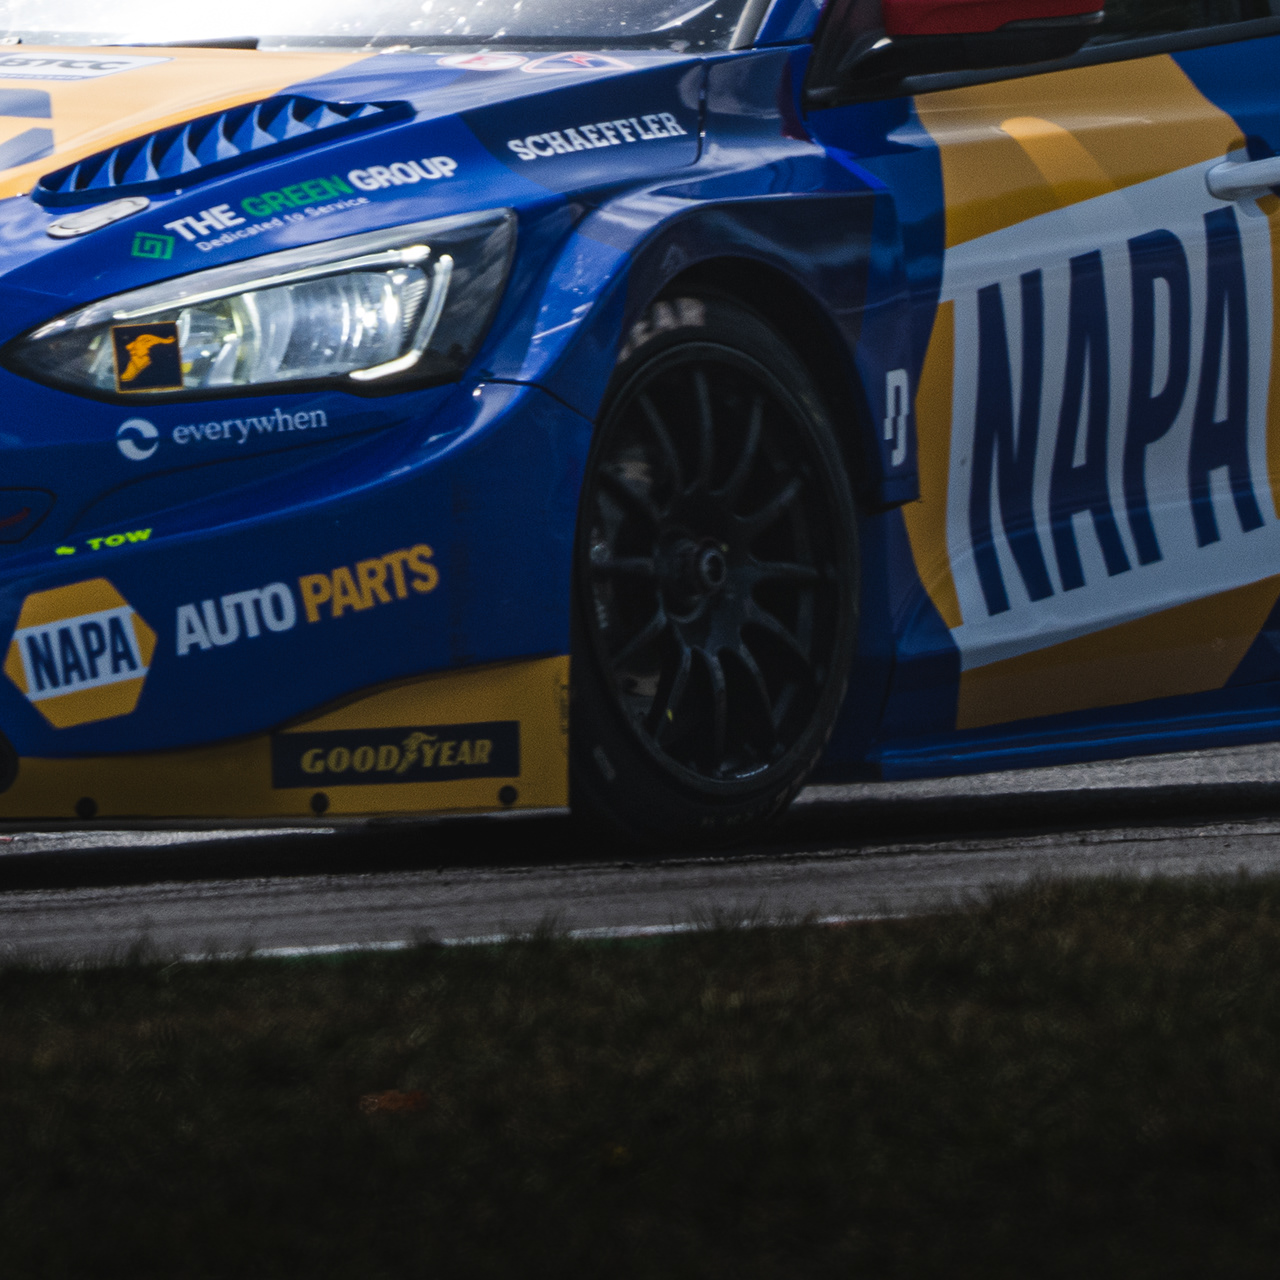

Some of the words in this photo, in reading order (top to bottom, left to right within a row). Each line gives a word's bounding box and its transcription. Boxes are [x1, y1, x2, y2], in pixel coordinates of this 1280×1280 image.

[508, 112, 688, 162] SCHAEFFLER
[163, 203, 246, 242] THE
[240, 175, 354, 218] GREEN
[348, 156, 458, 191] GROUP
[195, 216, 284, 252] Dedicated
[282, 210, 303, 224] to
[303, 196, 371, 218] Service
[173, 405, 328, 448] everywhen
[966, 205, 1267, 617] NAPA
[86, 528, 153, 551] TOW
[175, 581, 298, 656] AUTO
[298, 544, 439, 623] PARTS
[25, 614, 138, 694] NAPA
